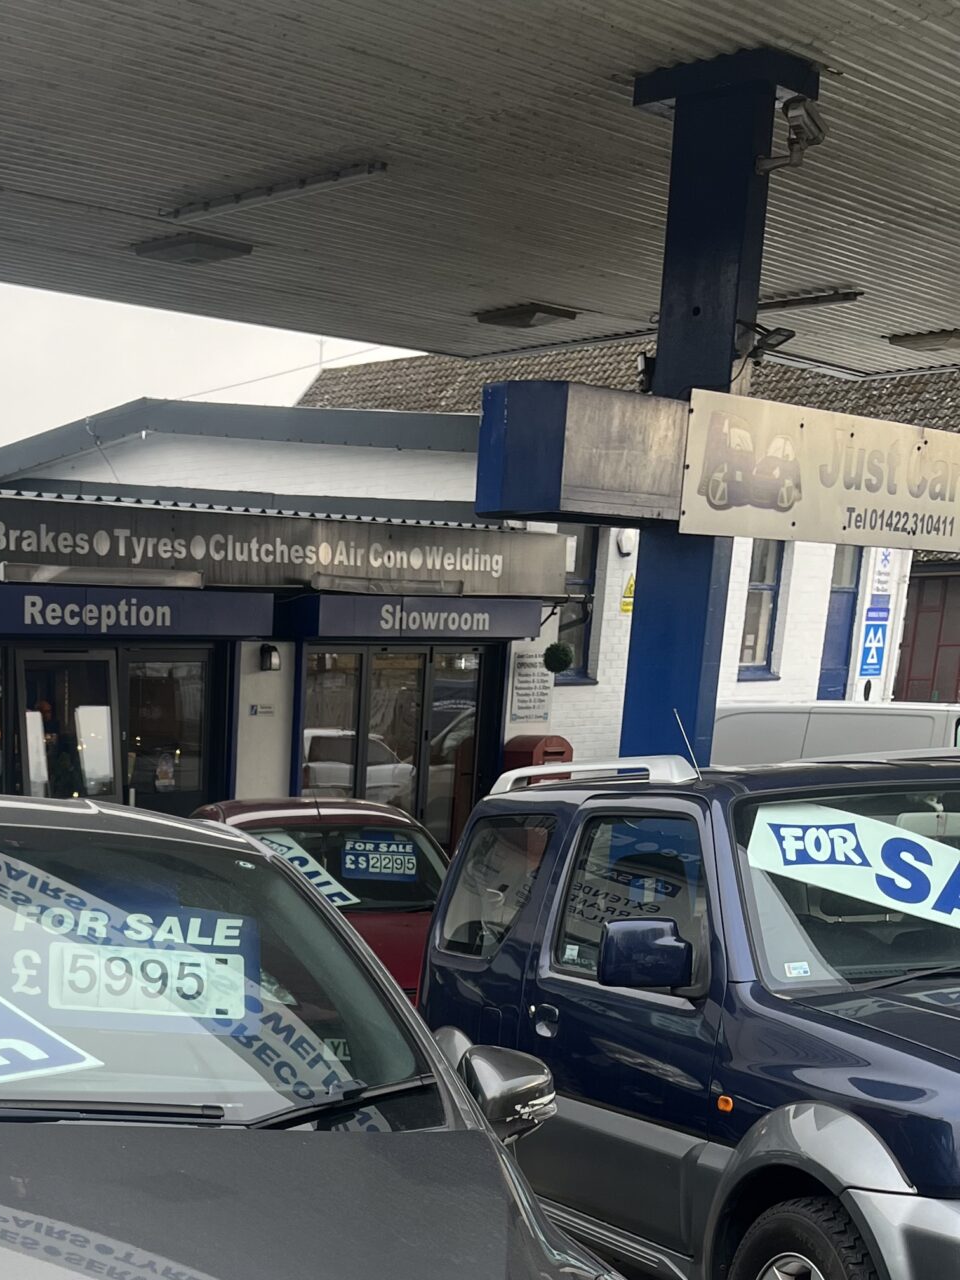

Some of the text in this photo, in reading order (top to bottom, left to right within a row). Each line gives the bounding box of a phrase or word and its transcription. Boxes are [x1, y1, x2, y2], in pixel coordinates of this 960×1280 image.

[818, 434, 900, 496] Just
[846, 507, 868, 529] Tel
[113, 528, 187, 564] Tyres
[209, 534, 317, 565] Clutches
[334, 541, 365, 567] Air
[369, 543, 412, 568] Con
[425, 546, 503, 578] Welding
[24, 595, 171, 633] Reception
[380, 604, 490, 631] Showroom
[345, 841, 413, 852] FOR SALE
[370, 857, 416, 870] 2295
[780, 827, 863, 865] FOR
[13, 905, 244, 947] FOR SALE
[67, 953, 205, 1000] 5995
